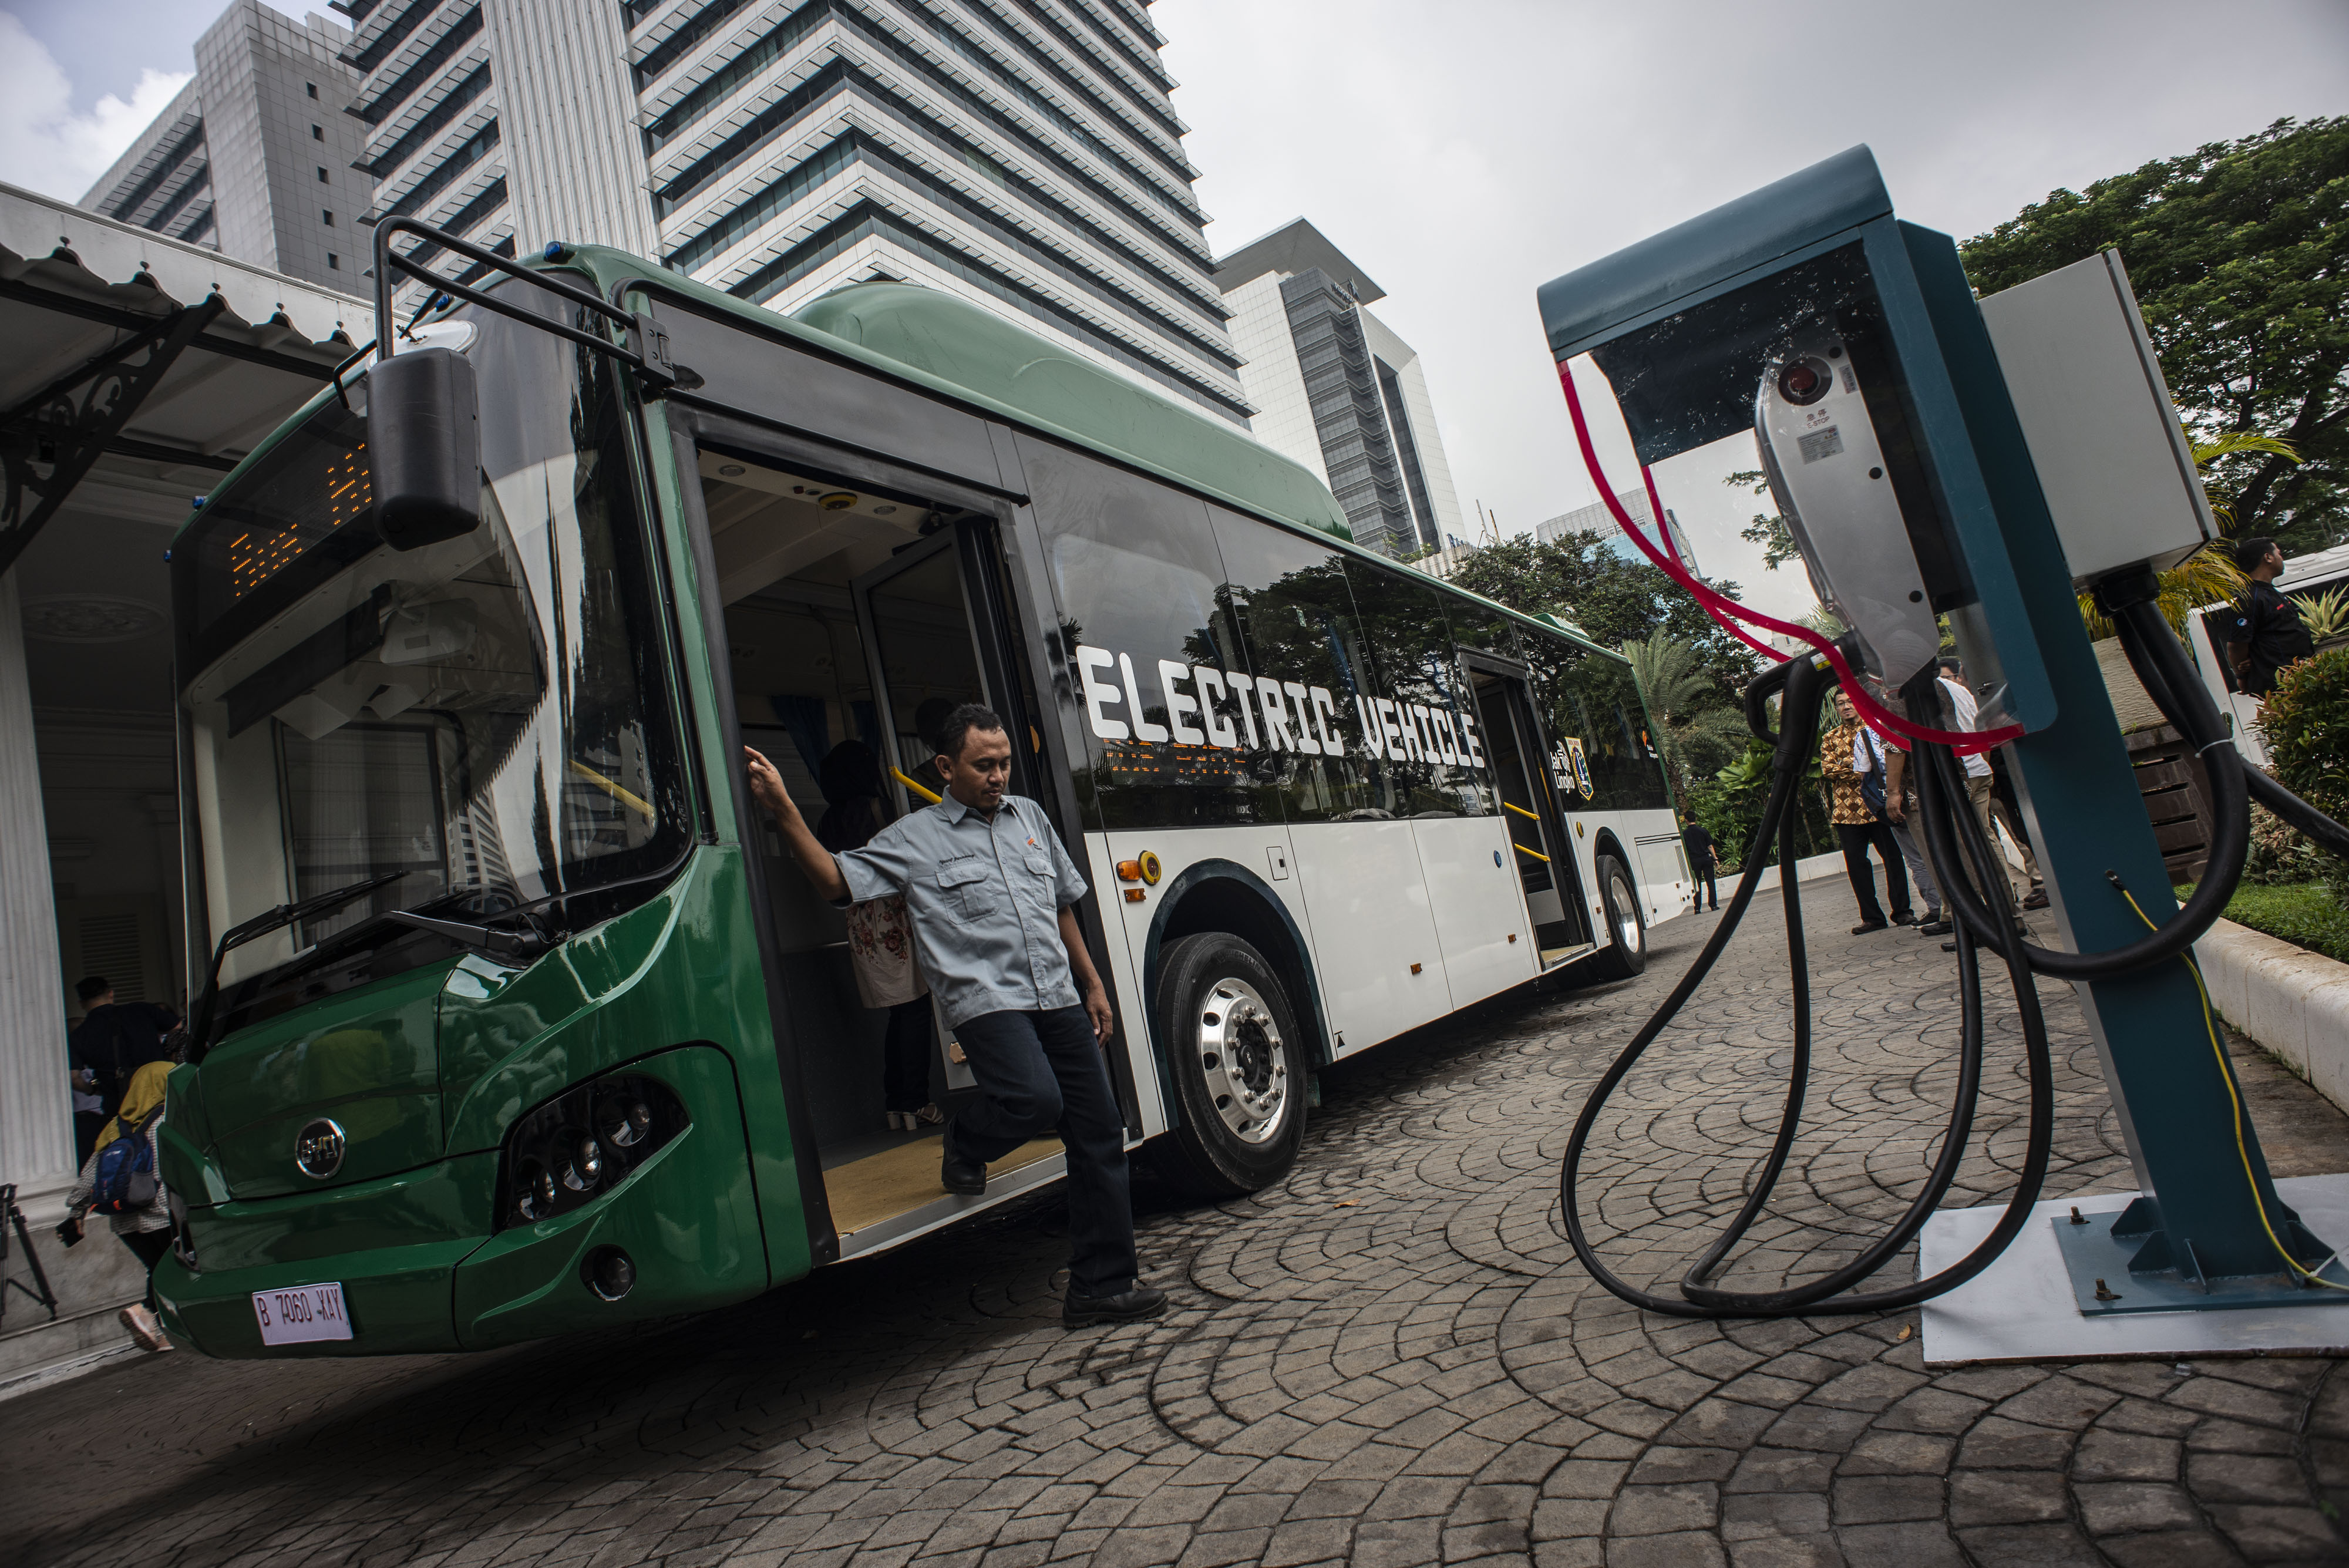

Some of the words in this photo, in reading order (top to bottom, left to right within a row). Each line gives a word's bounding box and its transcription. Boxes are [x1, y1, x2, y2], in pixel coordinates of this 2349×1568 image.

[1806, 416, 1830, 429] E-STOP
[1076, 645, 1344, 756] ELECTRIC
[1356, 694, 1485, 768] VEHICLE
[1554, 771, 1575, 793] Lingko
[301, 1135, 338, 1163] BYD
[257, 1296, 271, 1326] B
[275, 1291, 312, 1324] 7060
[316, 1288, 342, 1320] XAY
